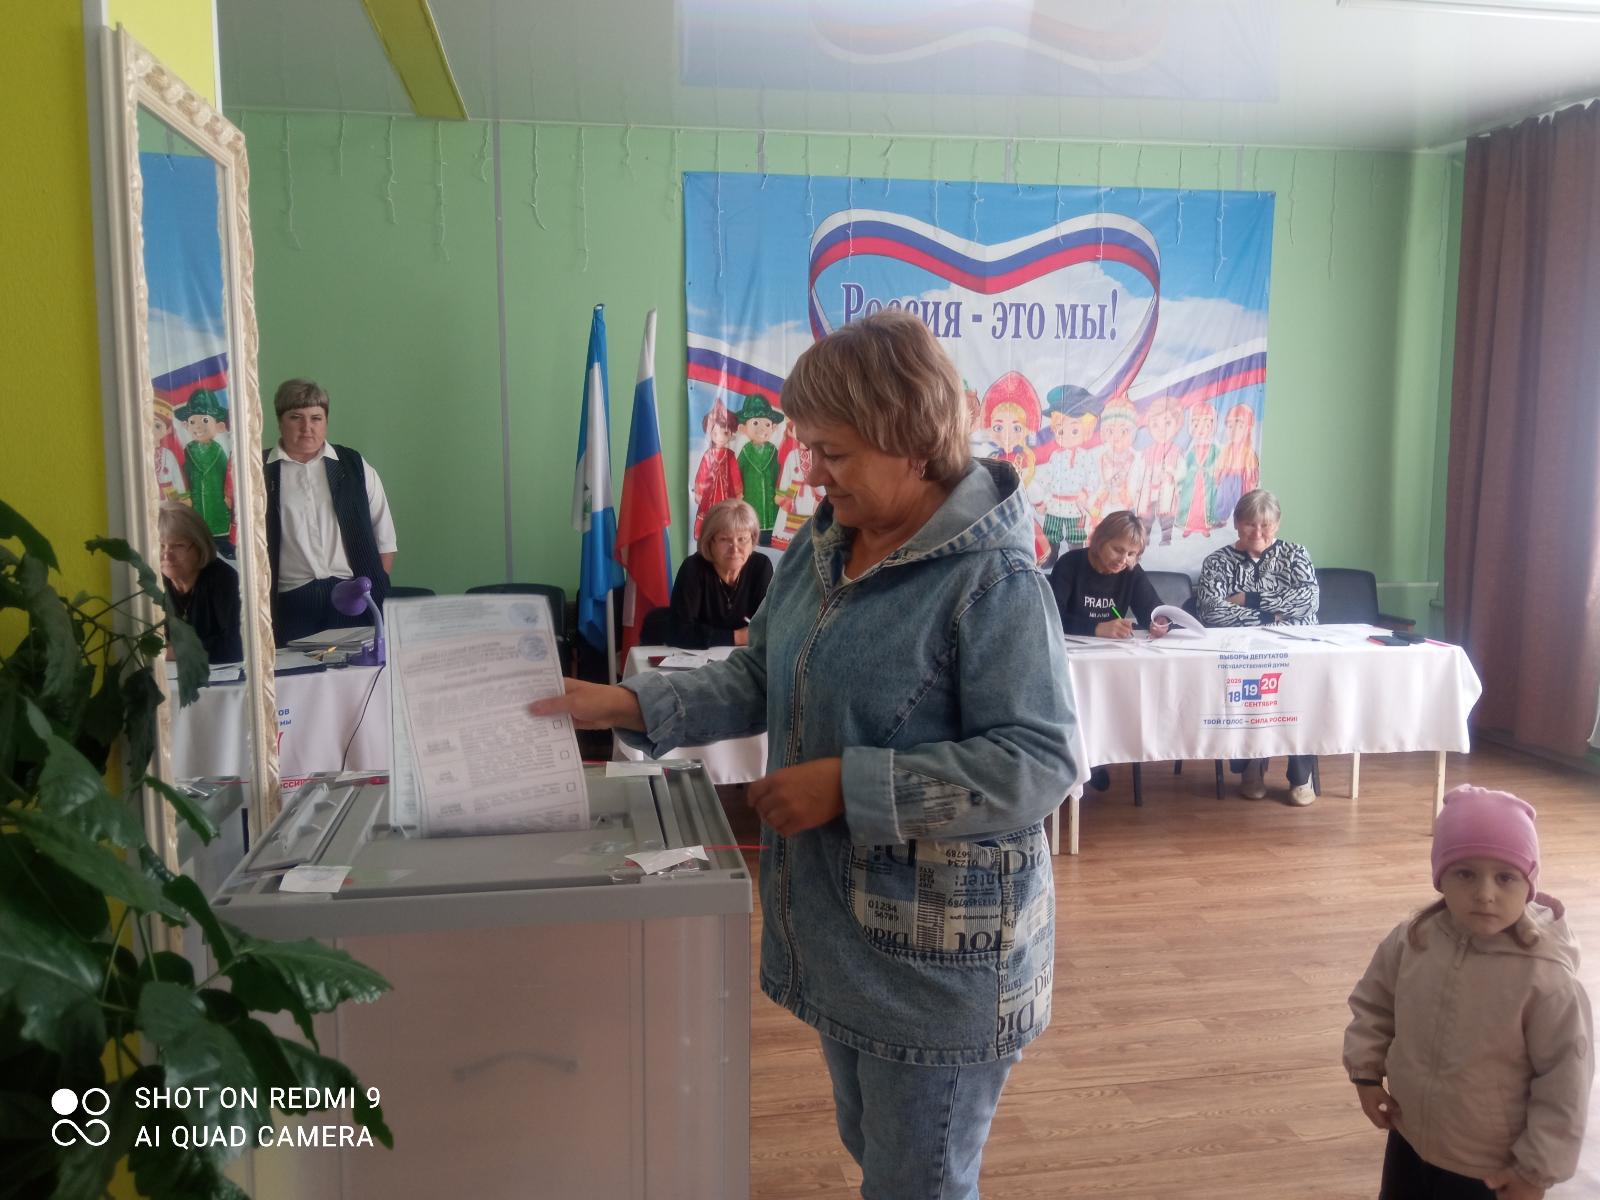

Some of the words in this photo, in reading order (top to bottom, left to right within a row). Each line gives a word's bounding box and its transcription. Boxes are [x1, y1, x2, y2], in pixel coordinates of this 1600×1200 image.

[991, 302, 1046, 339] это
[1055, 288, 1119, 341] мы!
[1084, 596, 1116, 609] PRADA
[1250, 652, 1289, 660] ДЕПУТАТОВ
[1228, 691, 1241, 702] 18
[1243, 684, 1258, 696] 19
[1260, 677, 1278, 690] 20
[1244, 700, 1278, 708] СЕНТЯБРЯ
[1269, 716, 1298, 724] РОССИИ!
